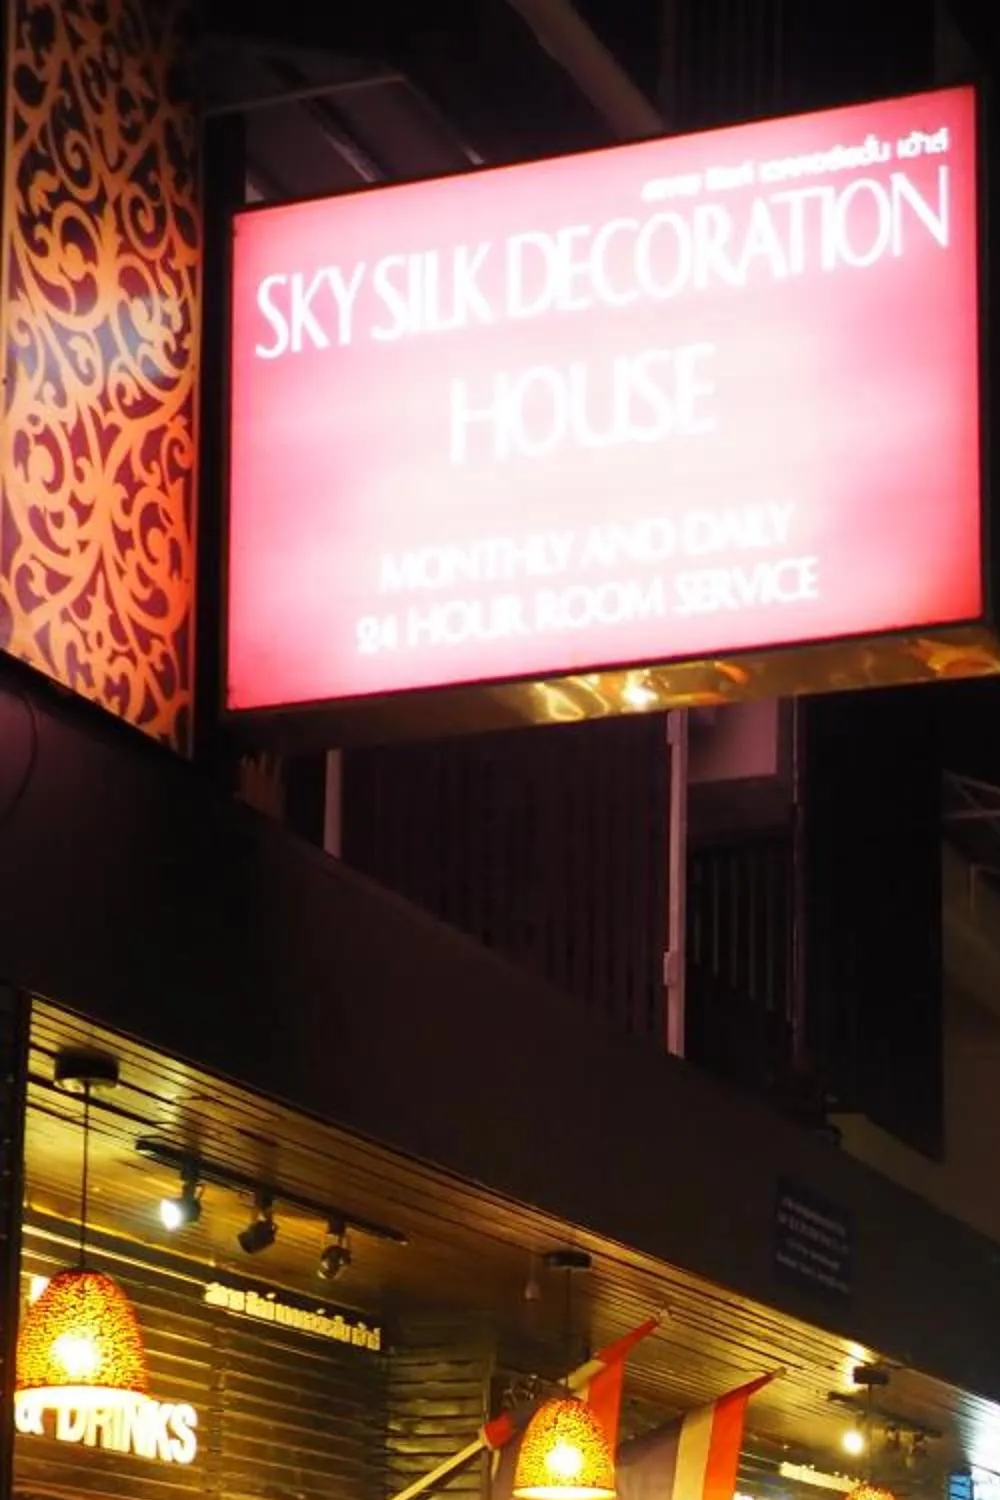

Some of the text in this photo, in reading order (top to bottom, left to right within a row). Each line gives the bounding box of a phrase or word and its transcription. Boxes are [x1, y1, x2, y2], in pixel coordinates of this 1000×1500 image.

[252, 163, 953, 361] SKY SILK DECORATION
[450, 342, 716, 466] HOUSE
[379, 501, 796, 592] MONTHLY AND DAILY
[406, 598, 530, 647] HOUR
[536, 576, 666, 631] ROOM
[674, 555, 819, 615] SERVICE
[56, 1400, 198, 1464] DRINKS
